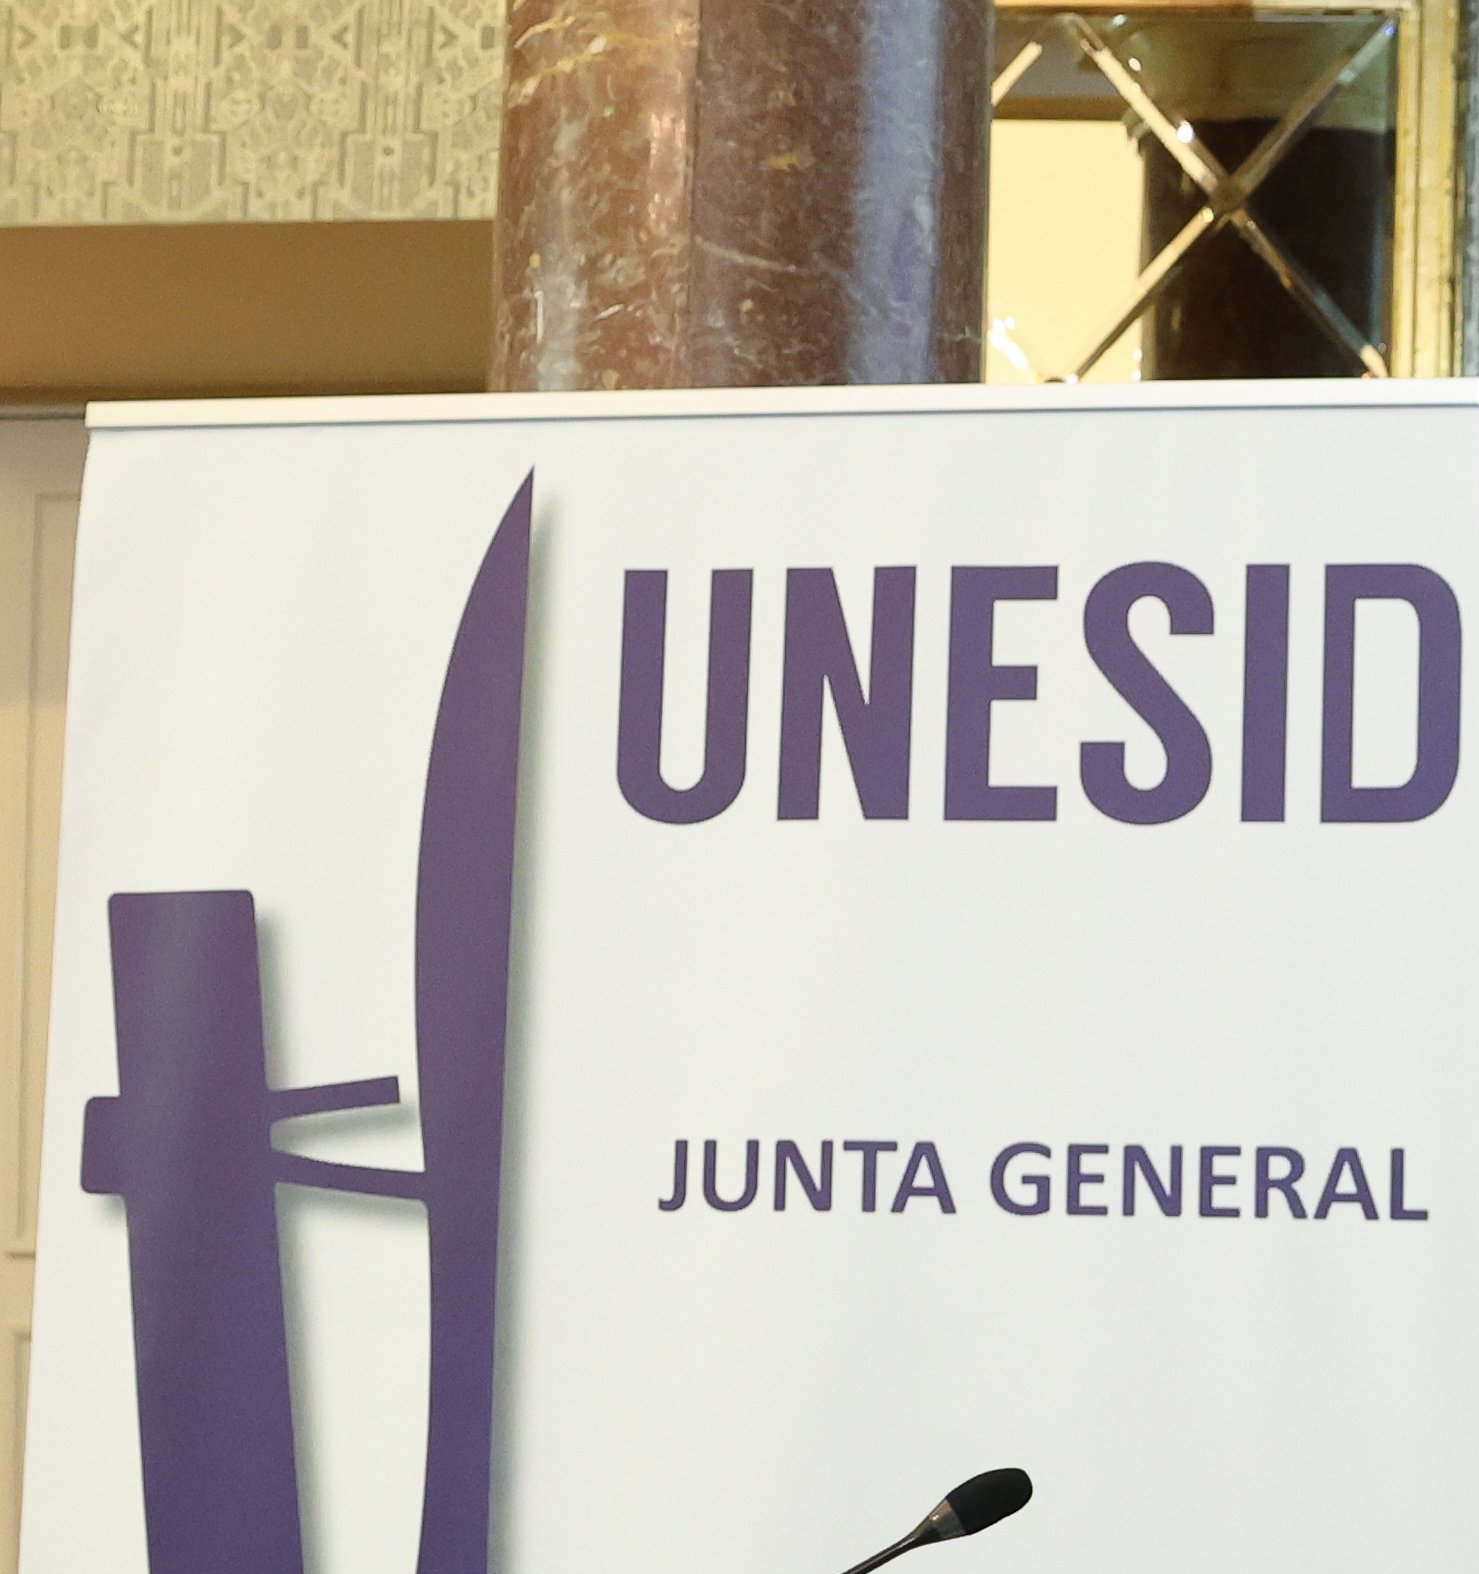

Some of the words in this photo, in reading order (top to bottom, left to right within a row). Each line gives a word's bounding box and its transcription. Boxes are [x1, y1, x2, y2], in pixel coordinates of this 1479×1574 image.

[615, 560, 1464, 826] UNESID
[658, 1137, 957, 1215] JUNTA
[988, 1140, 1431, 1223] GENERAL
